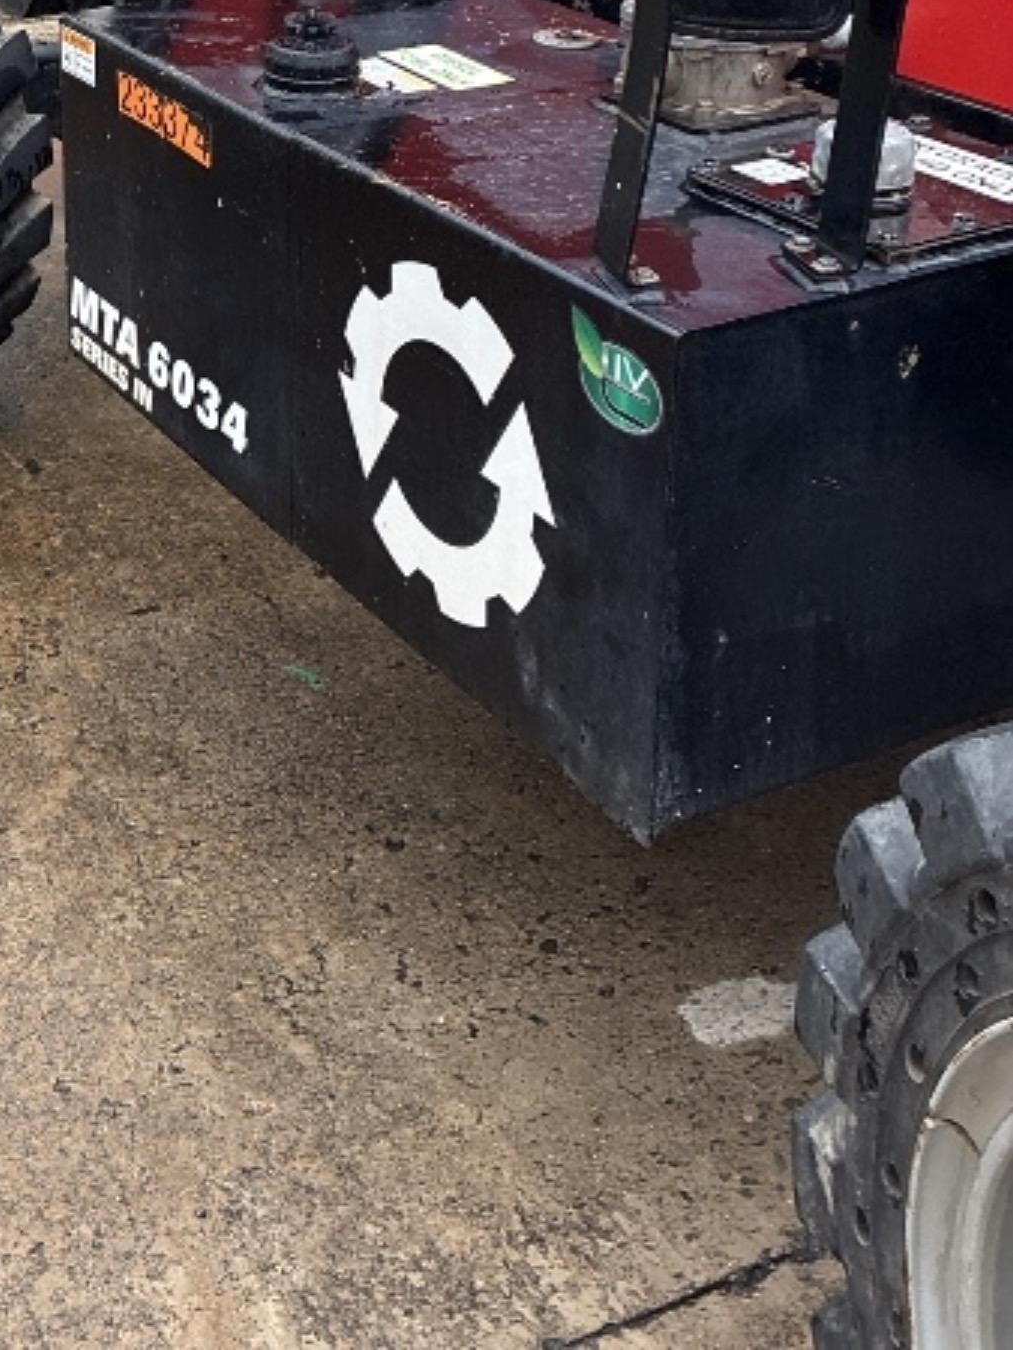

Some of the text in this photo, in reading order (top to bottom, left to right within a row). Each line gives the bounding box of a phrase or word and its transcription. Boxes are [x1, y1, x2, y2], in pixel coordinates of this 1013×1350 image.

[70, 327, 129, 391] SERIES
[70, 276, 248, 453] MTA 6034
